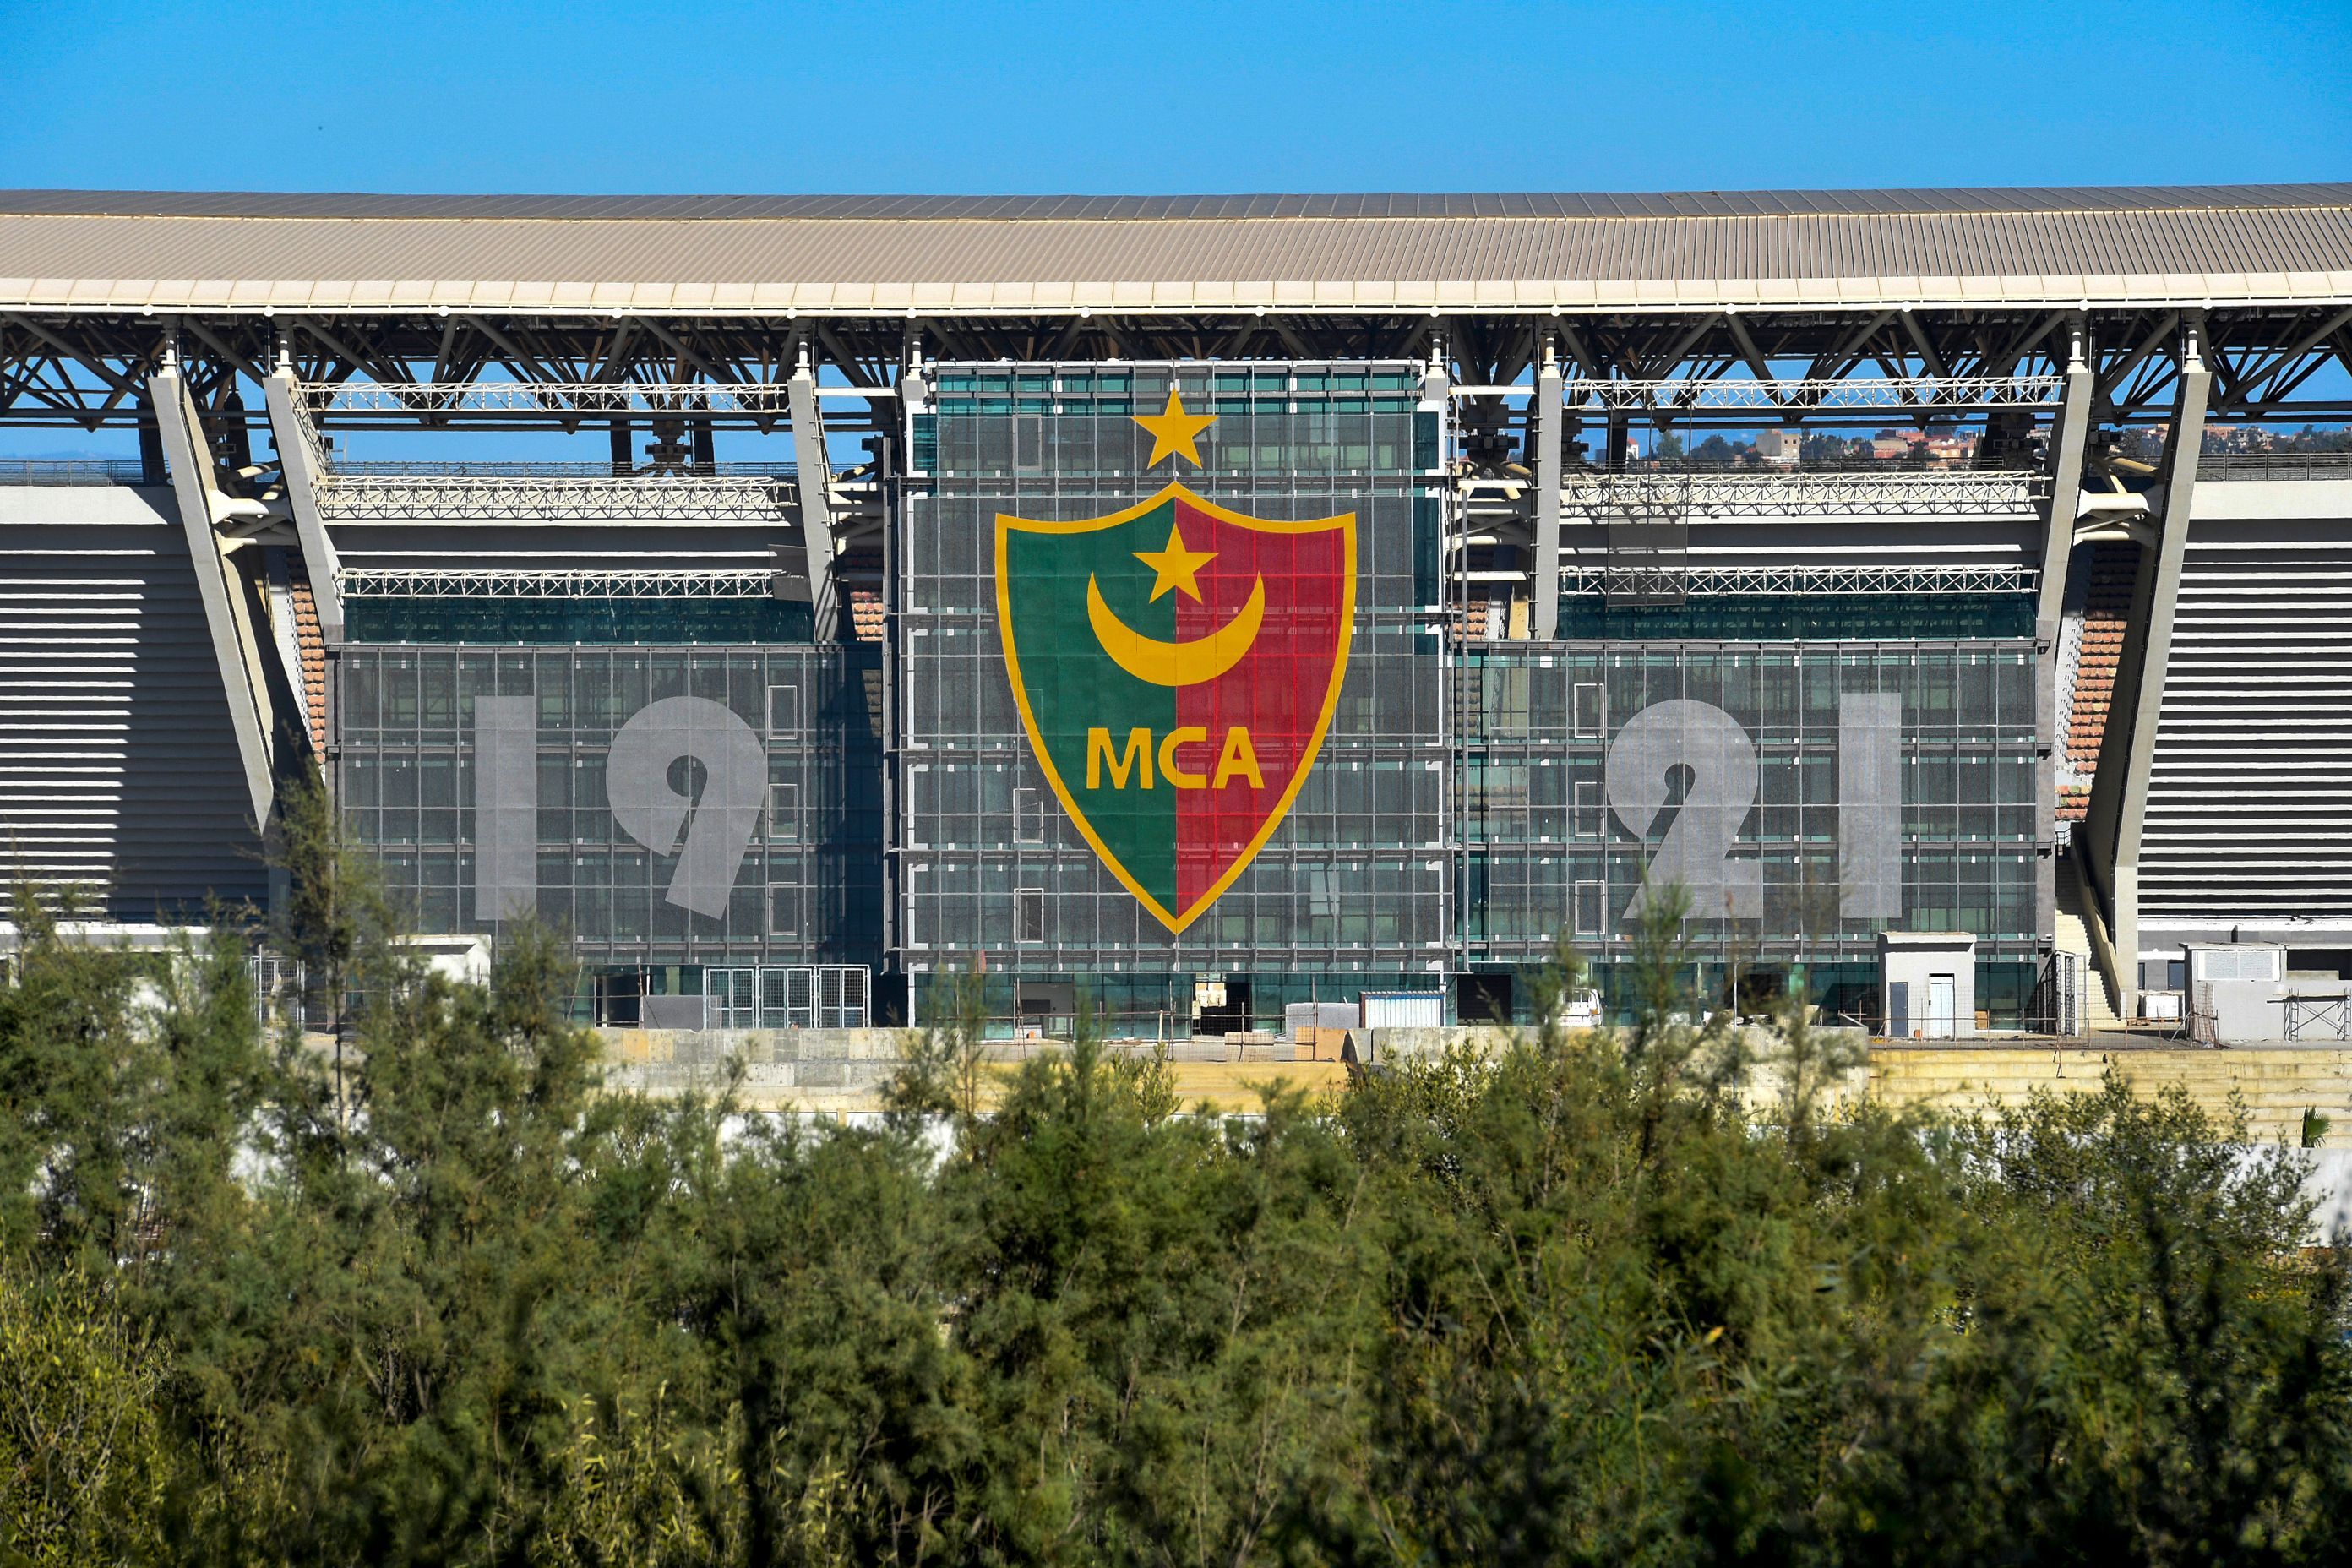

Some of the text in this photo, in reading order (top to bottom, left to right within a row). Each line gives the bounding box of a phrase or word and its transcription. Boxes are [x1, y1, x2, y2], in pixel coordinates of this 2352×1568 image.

[475, 695, 768, 920] 19
[1086, 727, 1266, 790] MCA
[1606, 693, 1902, 919] 21
